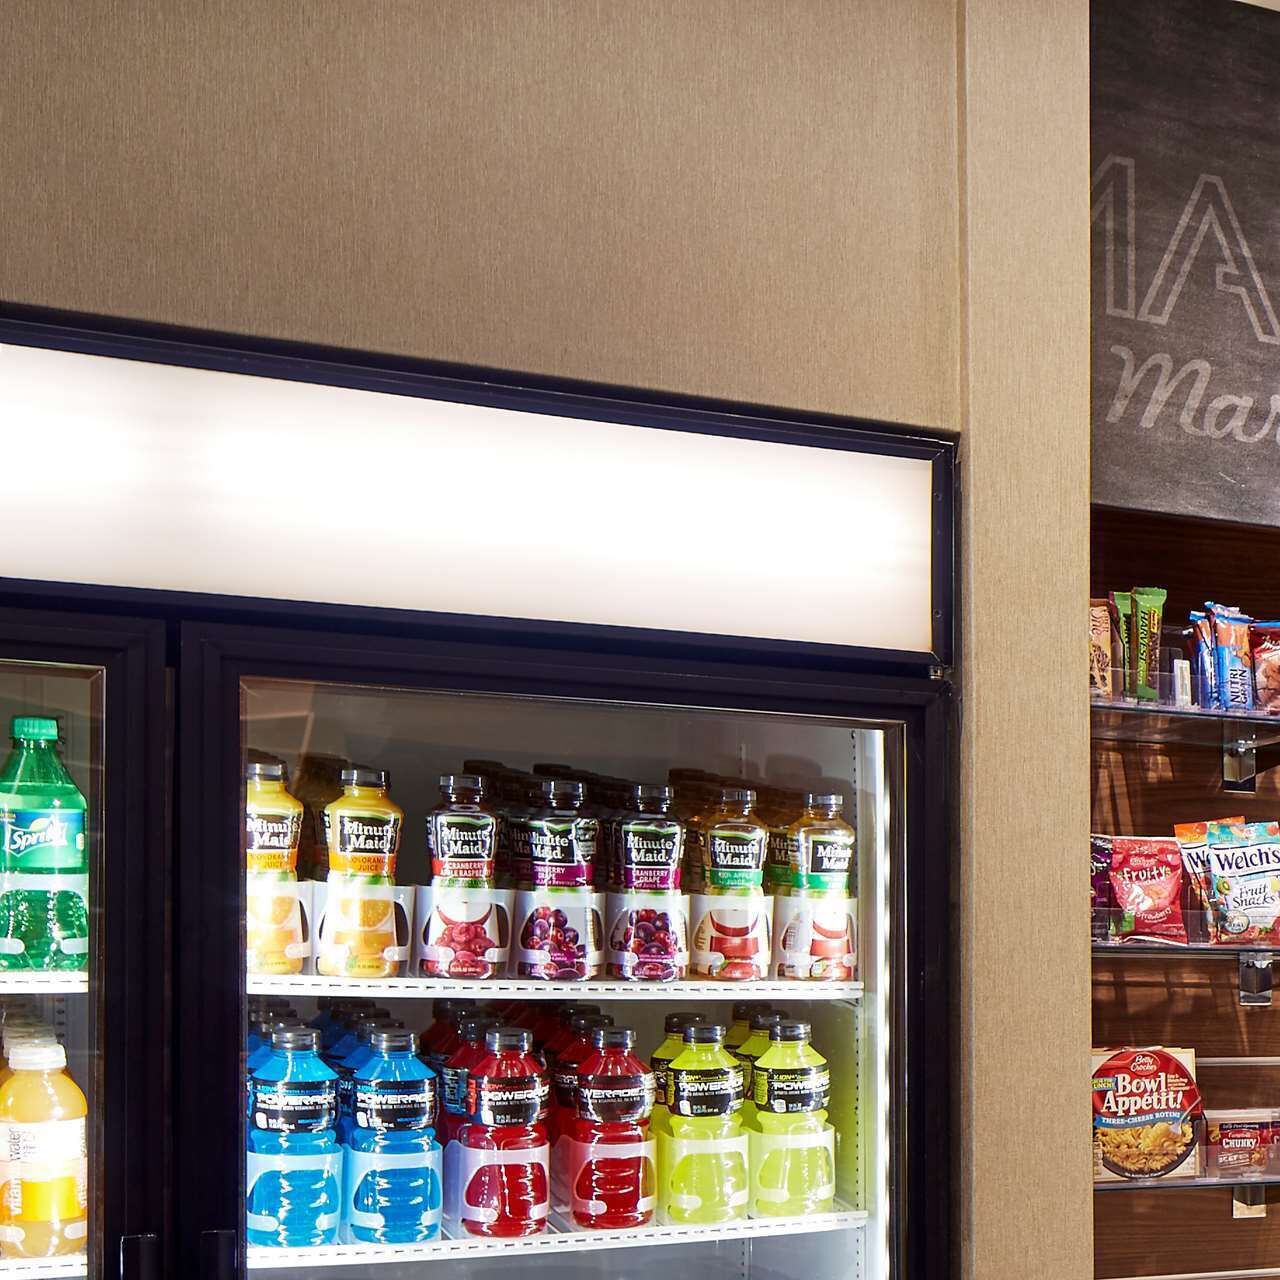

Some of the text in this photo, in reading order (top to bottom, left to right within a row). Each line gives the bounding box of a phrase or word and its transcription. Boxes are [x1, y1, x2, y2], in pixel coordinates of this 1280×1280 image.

[1138, 610, 1149, 664] HARVEST
[1230, 669, 1239, 703] NUTRI
[1240, 669, 1248, 704] GRAIN
[357, 864, 379, 872] JUICE
[638, 876, 660, 884] GRAPE
[1238, 883, 1268, 898] Fruit
[1232, 893, 1275, 907] Snacks
[1131, 1062, 1157, 1072] Crocker
[1135, 1056, 1154, 1066] Betty
[1115, 1073, 1167, 1096] Bowl
[1222, 1138, 1256, 1149] CHUNKY
